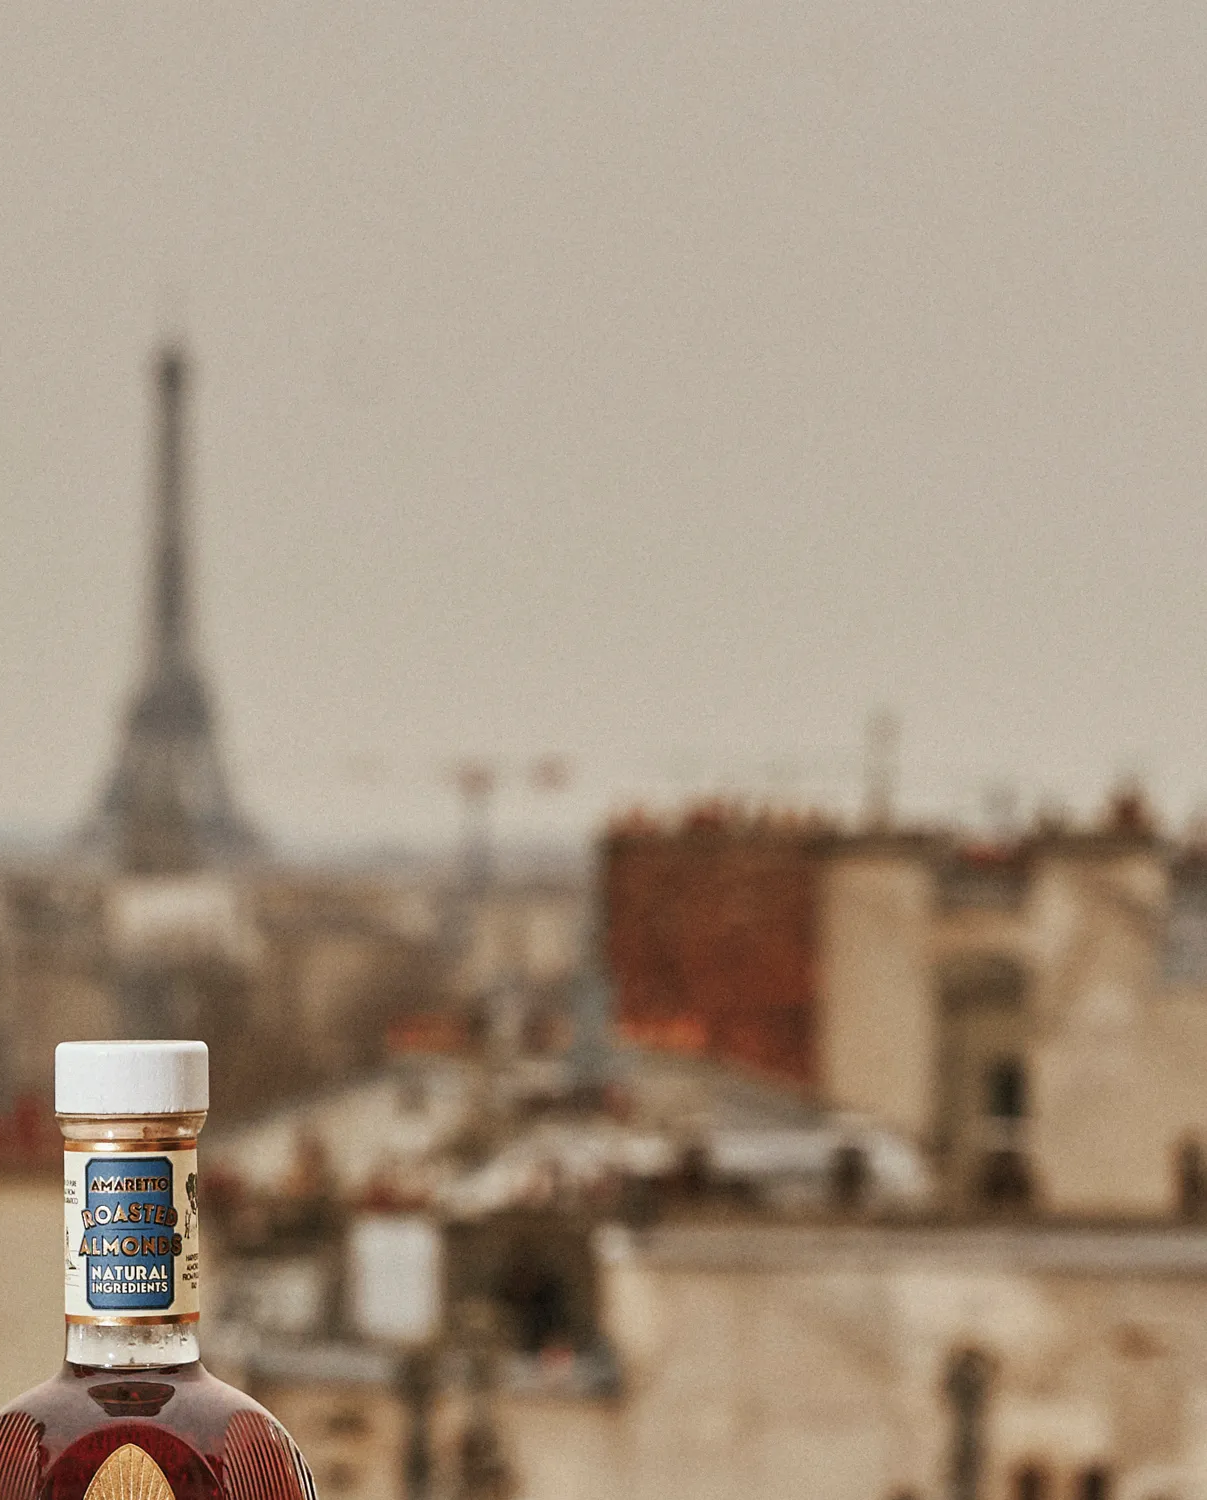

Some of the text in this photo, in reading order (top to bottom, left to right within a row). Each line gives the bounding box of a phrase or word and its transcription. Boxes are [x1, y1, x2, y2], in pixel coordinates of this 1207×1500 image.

[90, 1176, 169, 1193] AMARETTO
[81, 1202, 178, 1231] ROASTED
[78, 1233, 183, 1257] ALMONDS
[92, 1265, 168, 1281] NATURAL
[92, 1281, 168, 1294] INGREDIENTS
